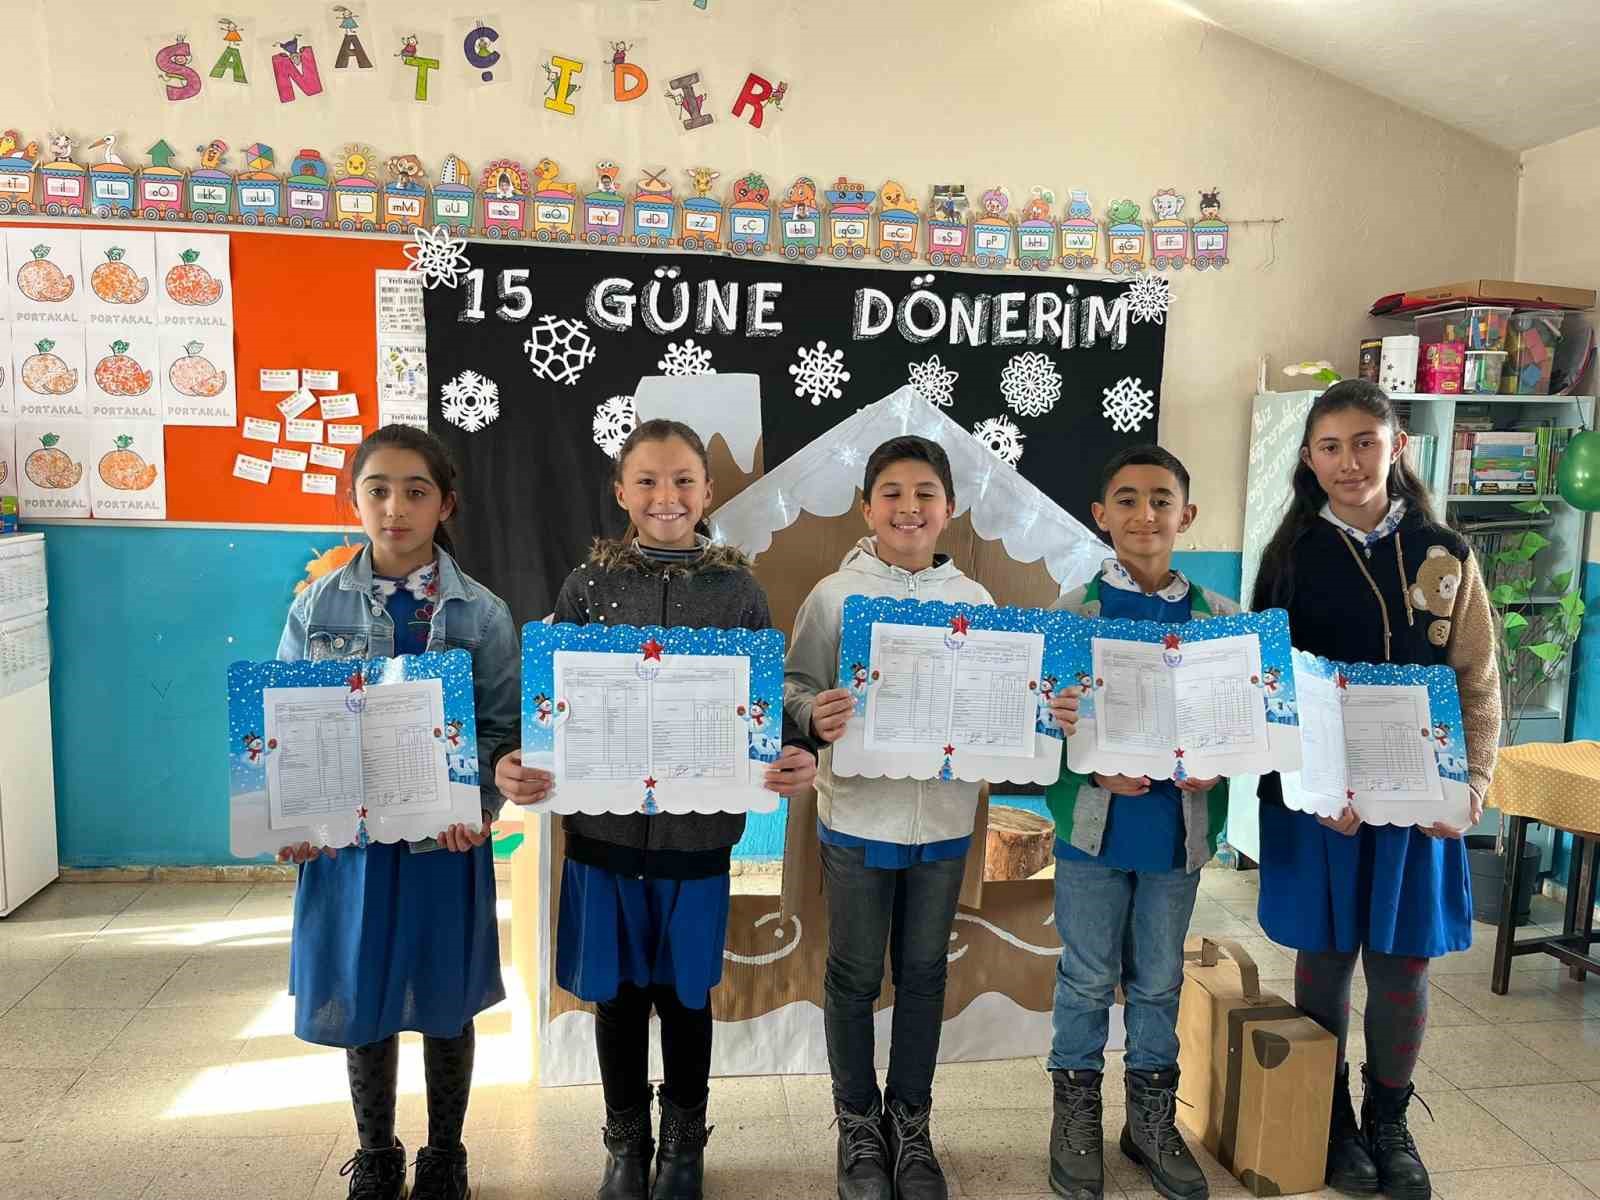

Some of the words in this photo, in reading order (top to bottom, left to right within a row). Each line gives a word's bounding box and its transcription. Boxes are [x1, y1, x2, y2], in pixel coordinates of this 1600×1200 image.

[457, 268, 533, 323] 15
[585, 266, 784, 337] GÜNE
[16, 311, 79, 323] PORTAKAL
[90, 313, 153, 326] PORTAKAL
[164, 315, 227, 327] PORTAKAL
[21, 404, 83, 415] PORTAKAL
[93, 406, 156, 417] PORTAKAL
[168, 407, 231, 417] PORTAKAL
[24, 498, 87, 509] PORTAKAL
[97, 499, 160, 511] PORTAKAL
